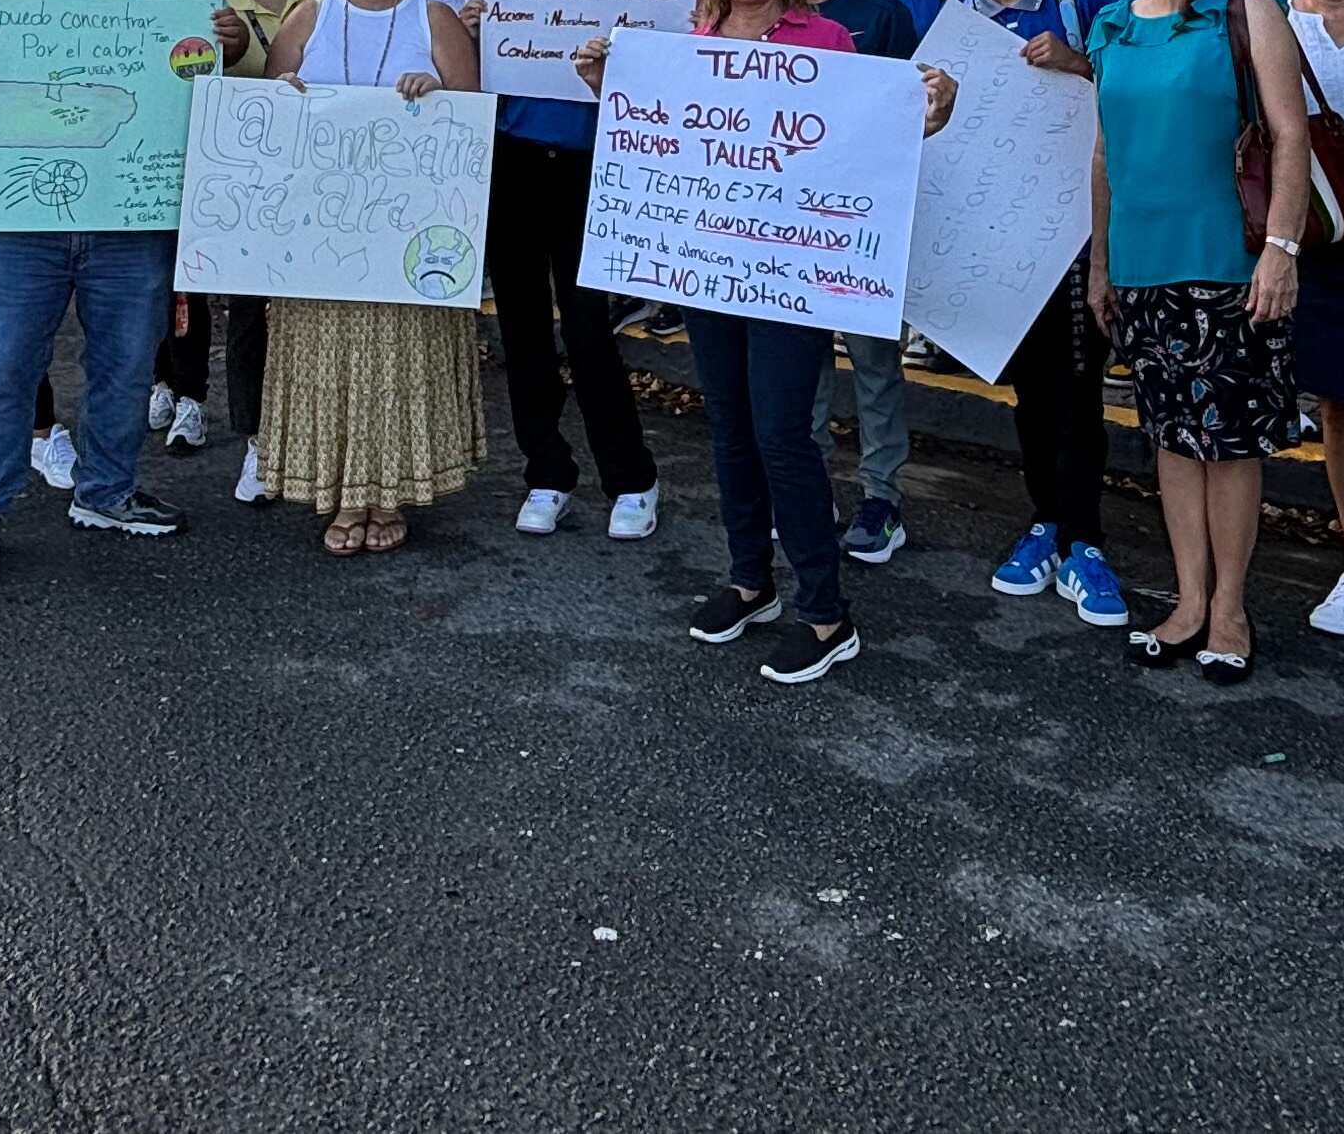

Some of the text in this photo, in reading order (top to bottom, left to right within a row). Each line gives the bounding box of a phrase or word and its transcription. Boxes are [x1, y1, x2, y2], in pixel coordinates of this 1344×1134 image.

[22, 33, 59, 60] Por
[66, 38, 81, 60] el
[696, 48, 819, 86] TEATRO
[200, 77, 282, 167] La
[608, 91, 826, 146] Desde 2016 NO
[700, 137, 784, 174] TALLER
[313, 169, 416, 234] alta
[638, 166, 720, 201] TEATRO
[796, 186, 874, 213] SUCIO
[635, 201, 689, 226] AIRE
[656, 233, 670, 255] de
[678, 241, 735, 268] almacen
[742, 259, 752, 281] y
